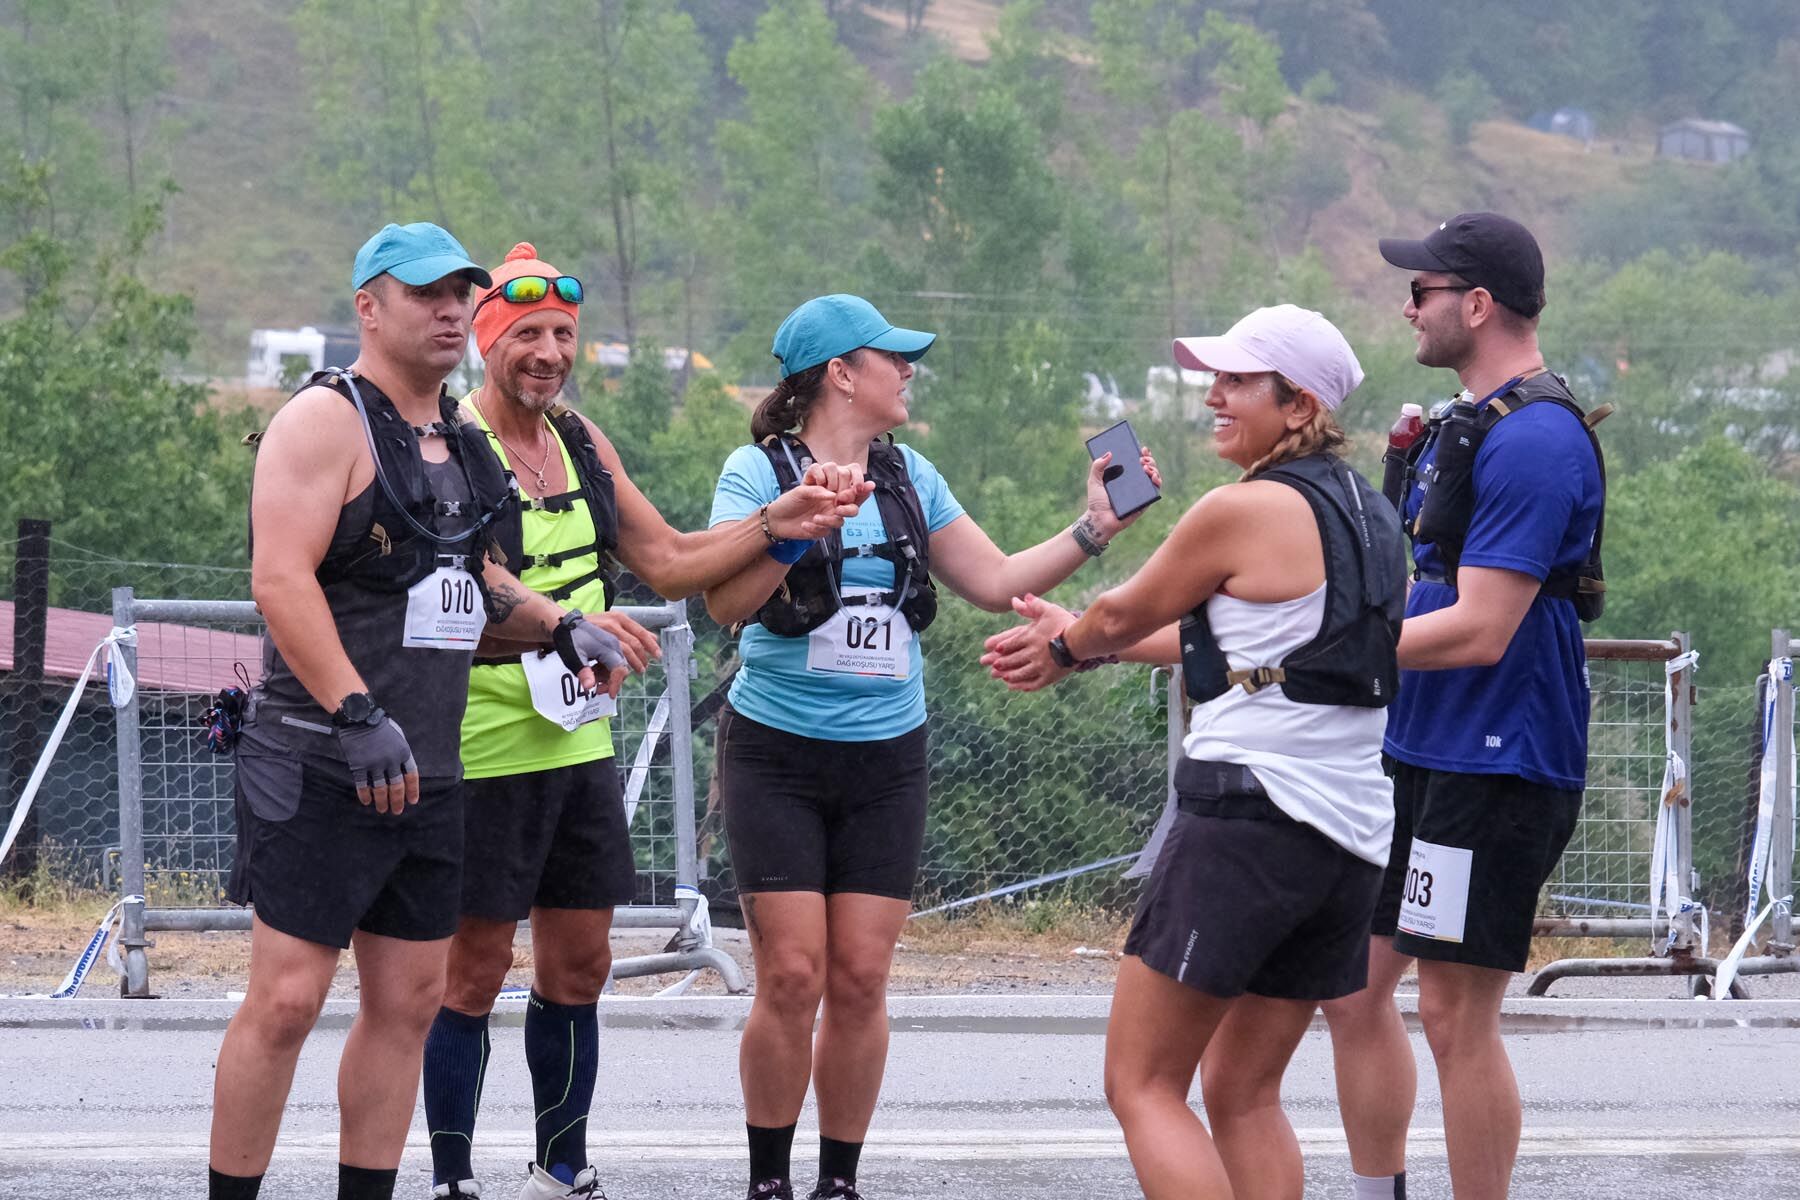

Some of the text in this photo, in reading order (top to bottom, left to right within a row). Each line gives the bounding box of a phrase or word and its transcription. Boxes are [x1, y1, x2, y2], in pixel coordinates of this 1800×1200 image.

[441, 578, 474, 614] 010
[846, 615, 891, 651] 021
[561, 672, 598, 707] 04
[1485, 735, 1502, 748] 10k
[1183, 928, 1200, 961] EVADICT
